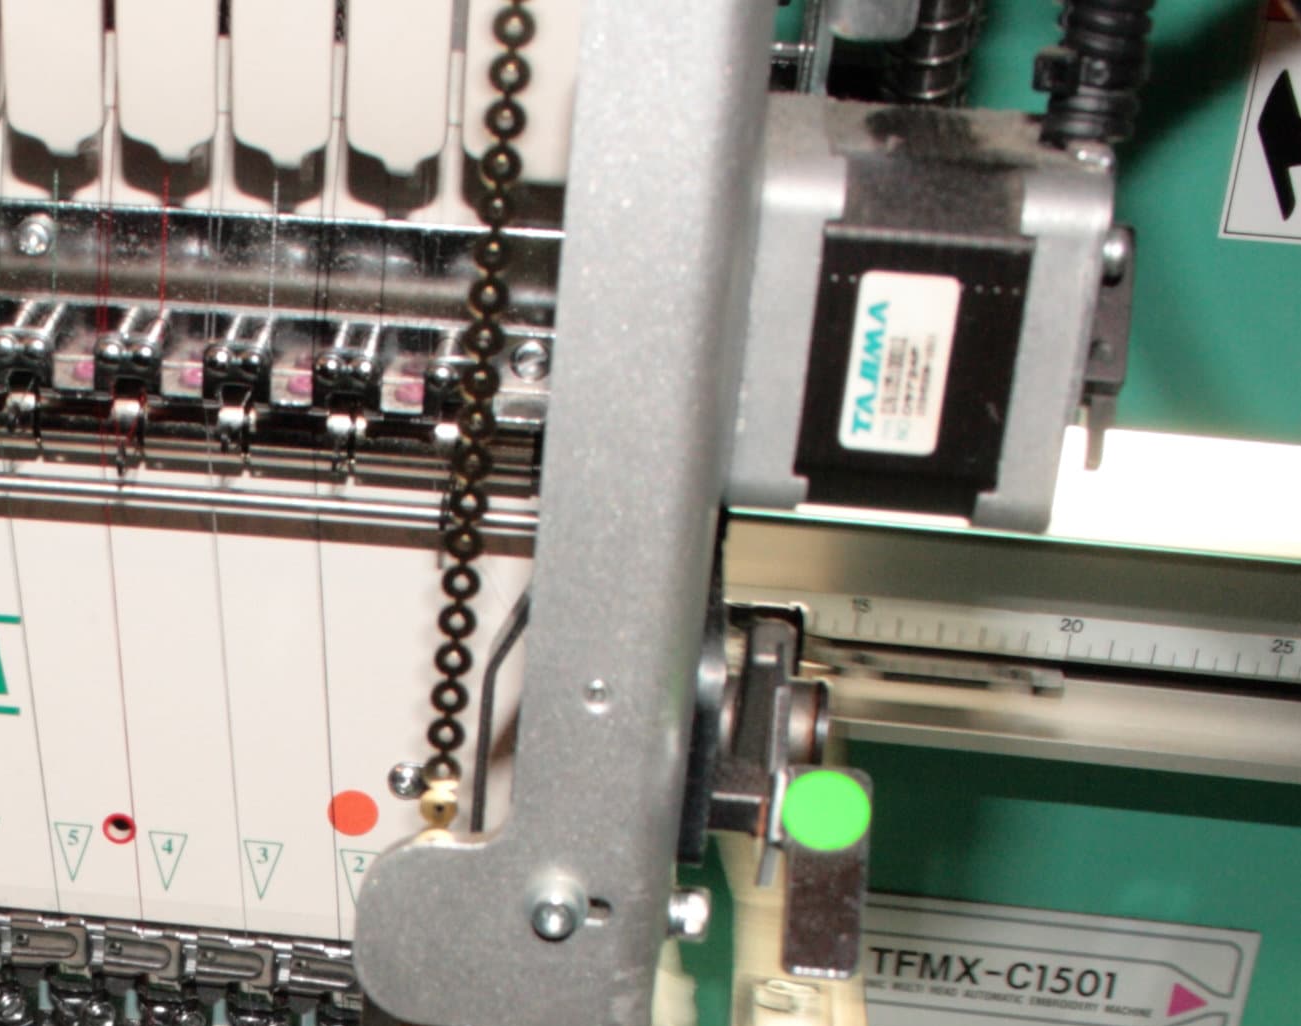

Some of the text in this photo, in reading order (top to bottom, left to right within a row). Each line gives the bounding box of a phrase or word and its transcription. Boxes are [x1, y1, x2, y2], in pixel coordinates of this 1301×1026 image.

[851, 299, 890, 434] TAJIMA
[1060, 617, 1085, 634] 20
[1270, 638, 1296, 656] 25
[66, 829, 80, 847] 5
[161, 837, 174, 855] 4
[255, 846, 270, 865] 3
[352, 855, 366, 873] 2
[867, 946, 1117, 999] TFMX-C1501
[929, 985, 959, 998] HEAD
[962, 989, 1025, 1004] AUTOMATIC
[1028, 995, 1099, 1013] EMBROIDERY
[1103, 1004, 1154, 1019] MACHINE
